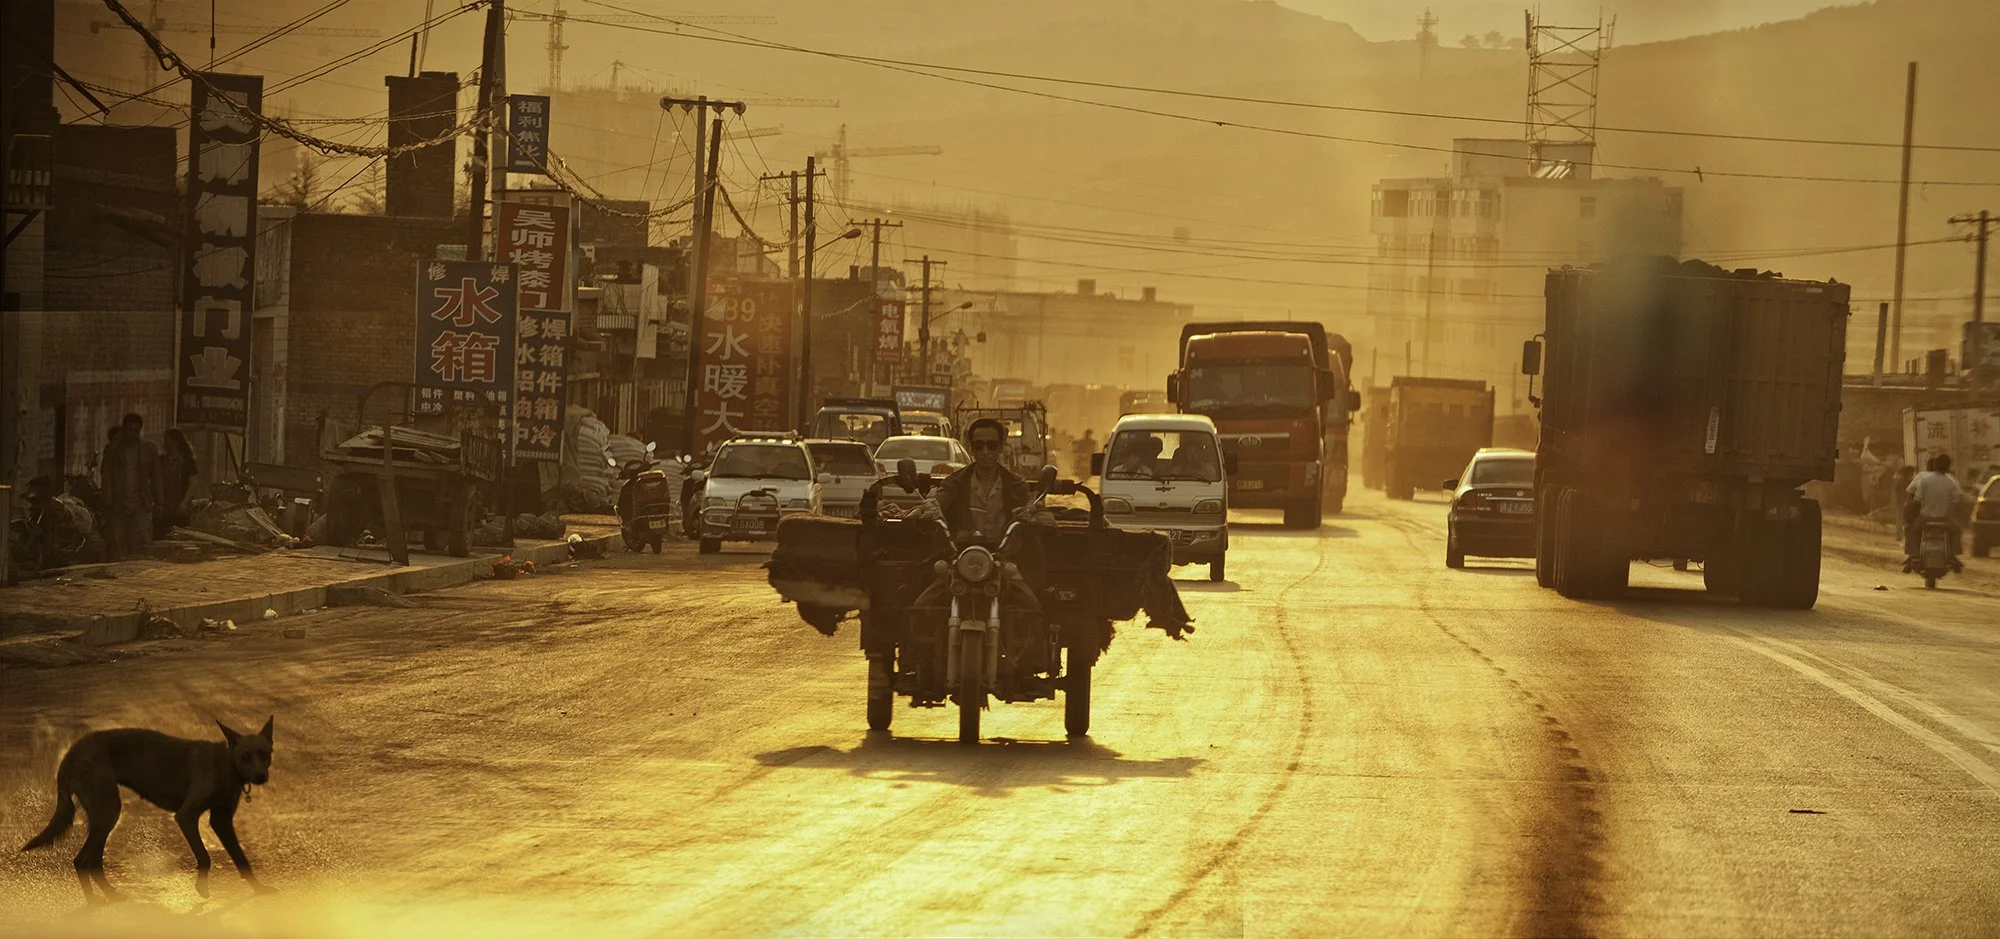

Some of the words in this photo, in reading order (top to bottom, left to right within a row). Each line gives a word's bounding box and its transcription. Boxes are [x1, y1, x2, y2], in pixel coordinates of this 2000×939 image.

[428, 263, 446, 281] 修
[491, 266, 510, 284] 焊
[431, 277, 503, 382] 水箱
